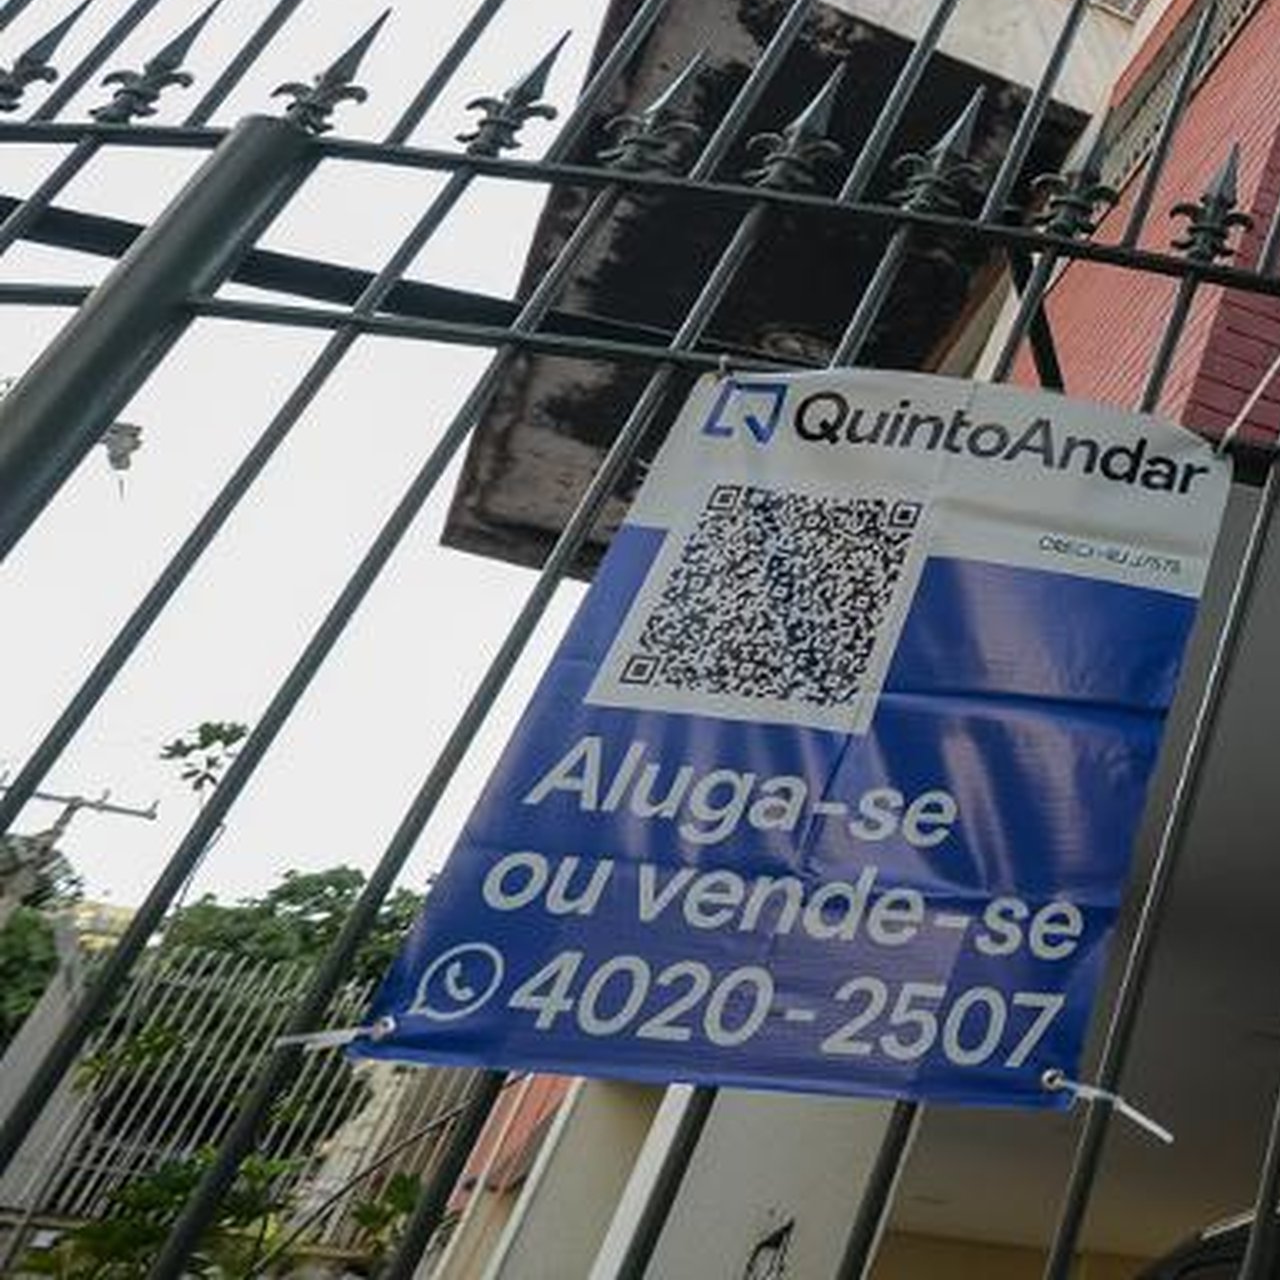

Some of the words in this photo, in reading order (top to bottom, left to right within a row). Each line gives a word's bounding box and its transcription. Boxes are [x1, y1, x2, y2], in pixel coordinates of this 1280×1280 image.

[794, 391, 1209, 496] QuintoAndar
[524, 735, 959, 846] Aluga-se
[482, 851, 613, 916] ou
[637, 862, 1084, 960] vende-se
[508, 950, 1066, 1069] 4020-2507
